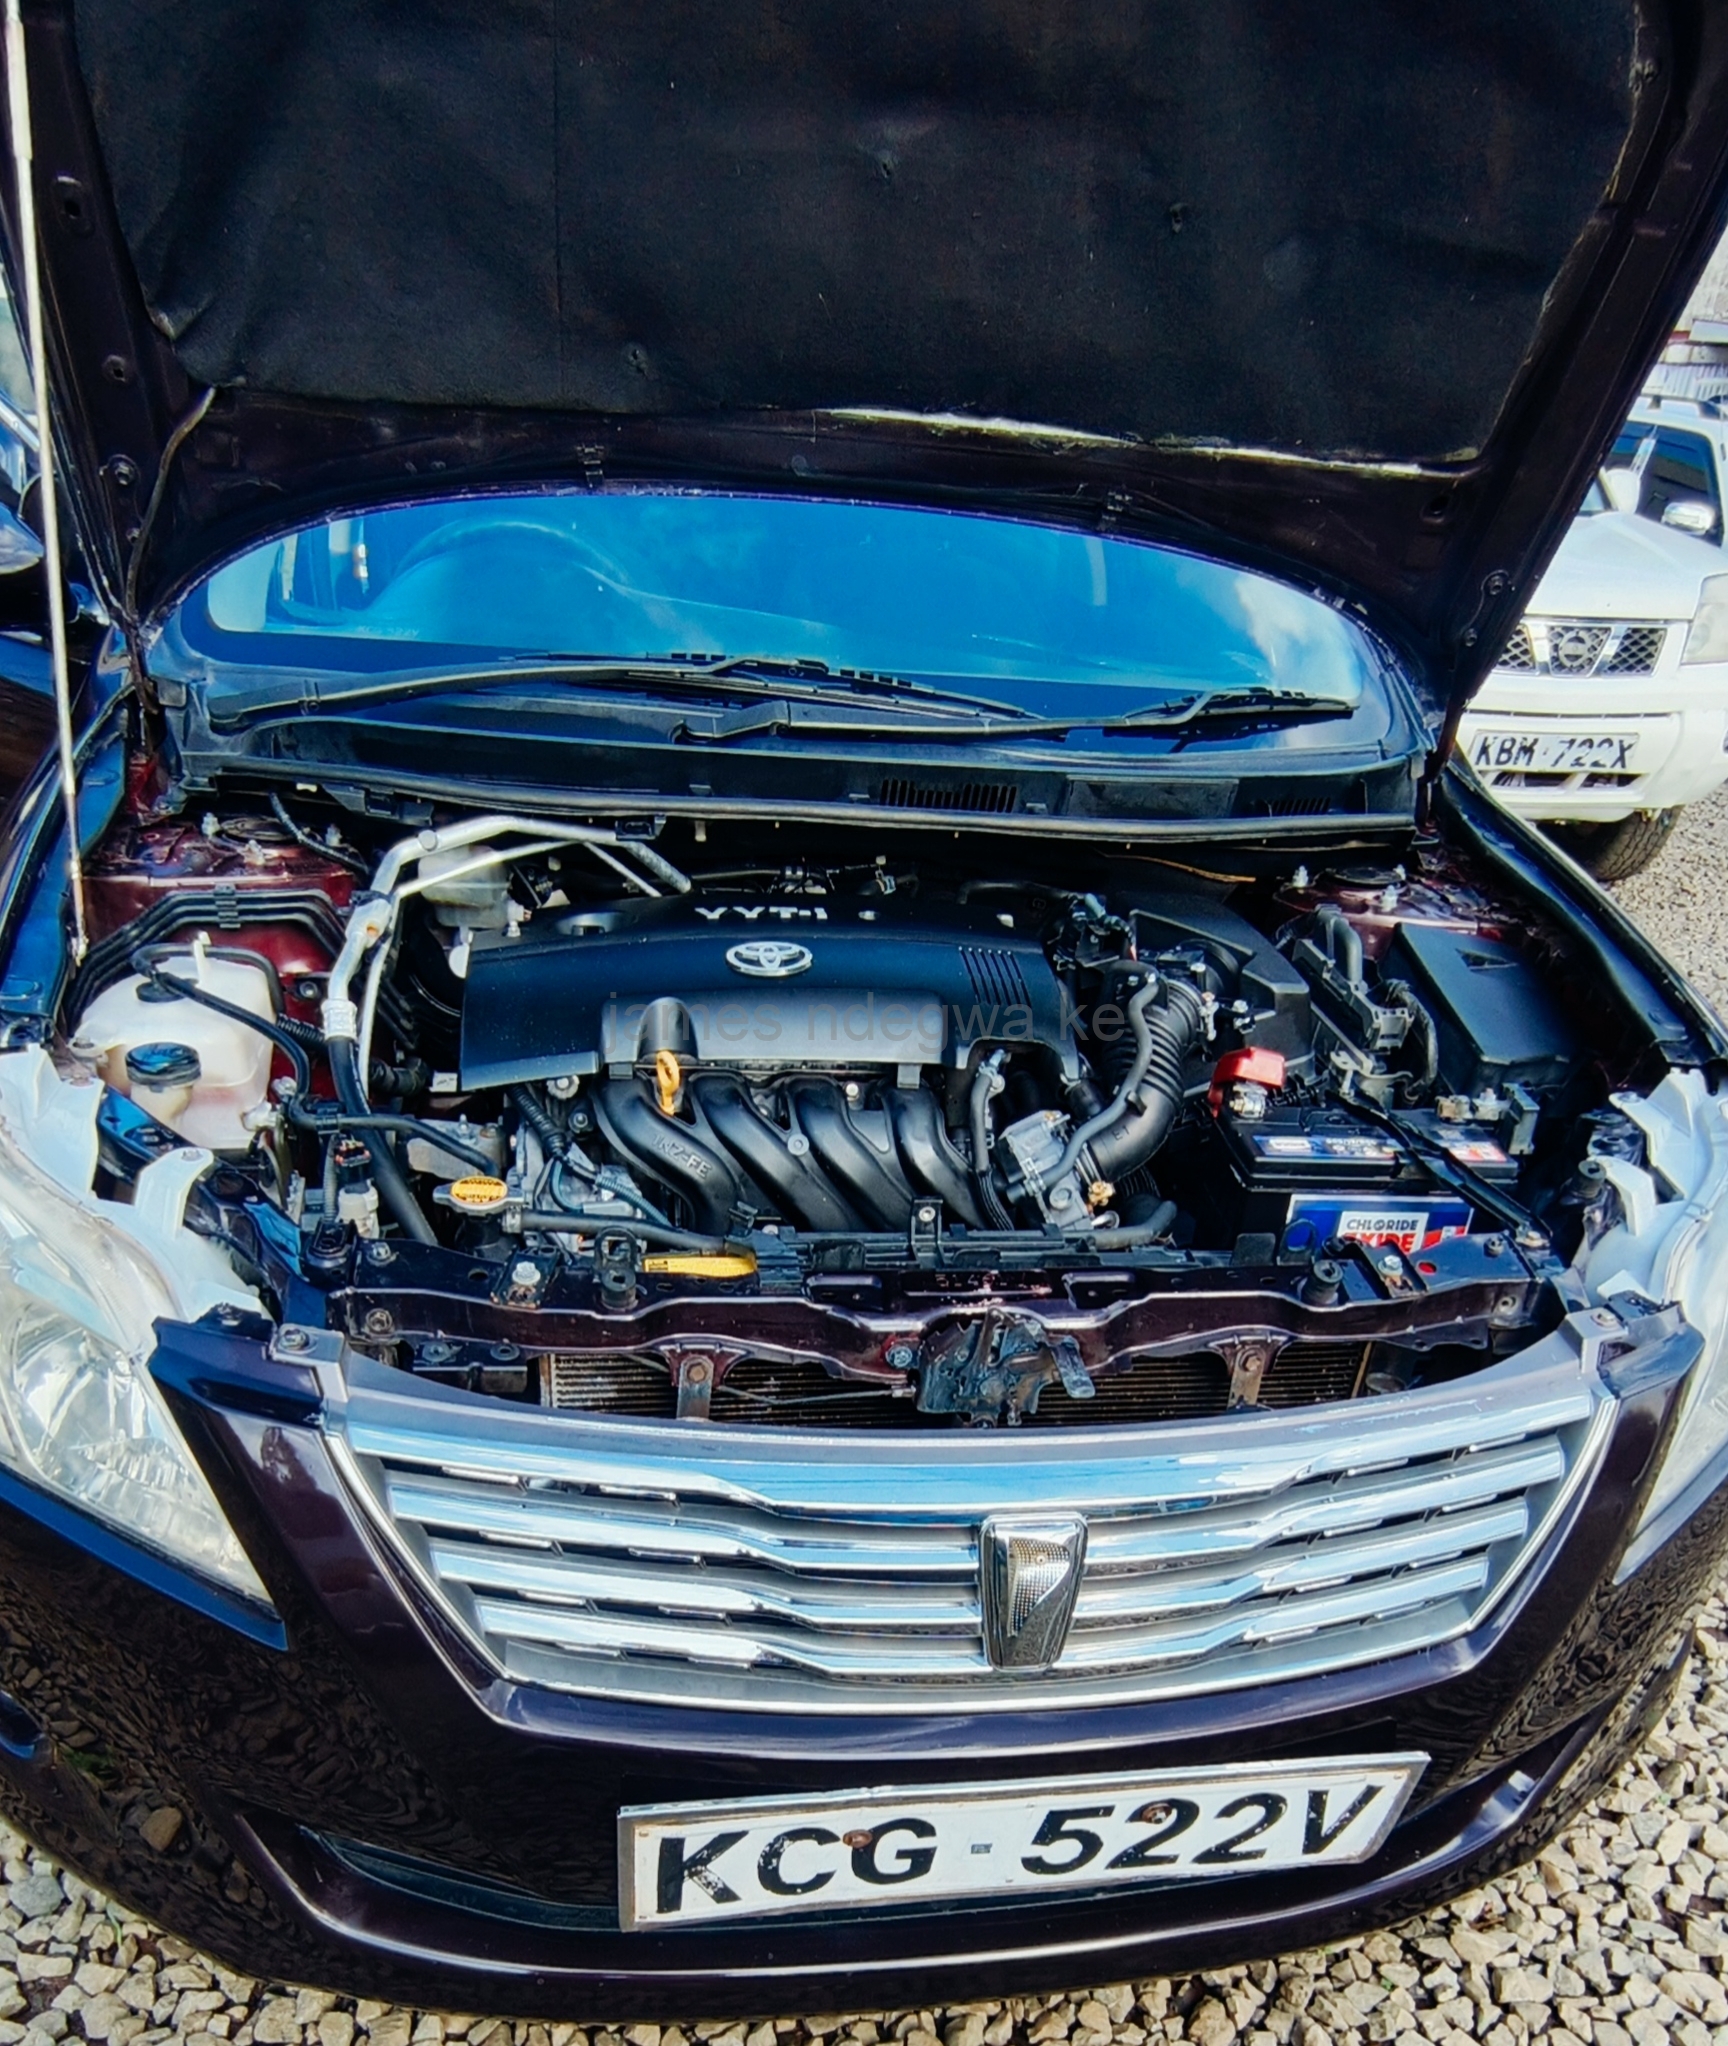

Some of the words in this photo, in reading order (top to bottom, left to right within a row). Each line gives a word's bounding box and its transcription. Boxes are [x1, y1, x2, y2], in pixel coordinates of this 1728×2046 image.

[1475, 736, 1539, 766] KBM
[1551, 737, 1636, 769] 722X
[1346, 1219, 1419, 1231] CHLORIDE
[657, 1818, 938, 1914] KCG
[1020, 1784, 1385, 1875] 522V
